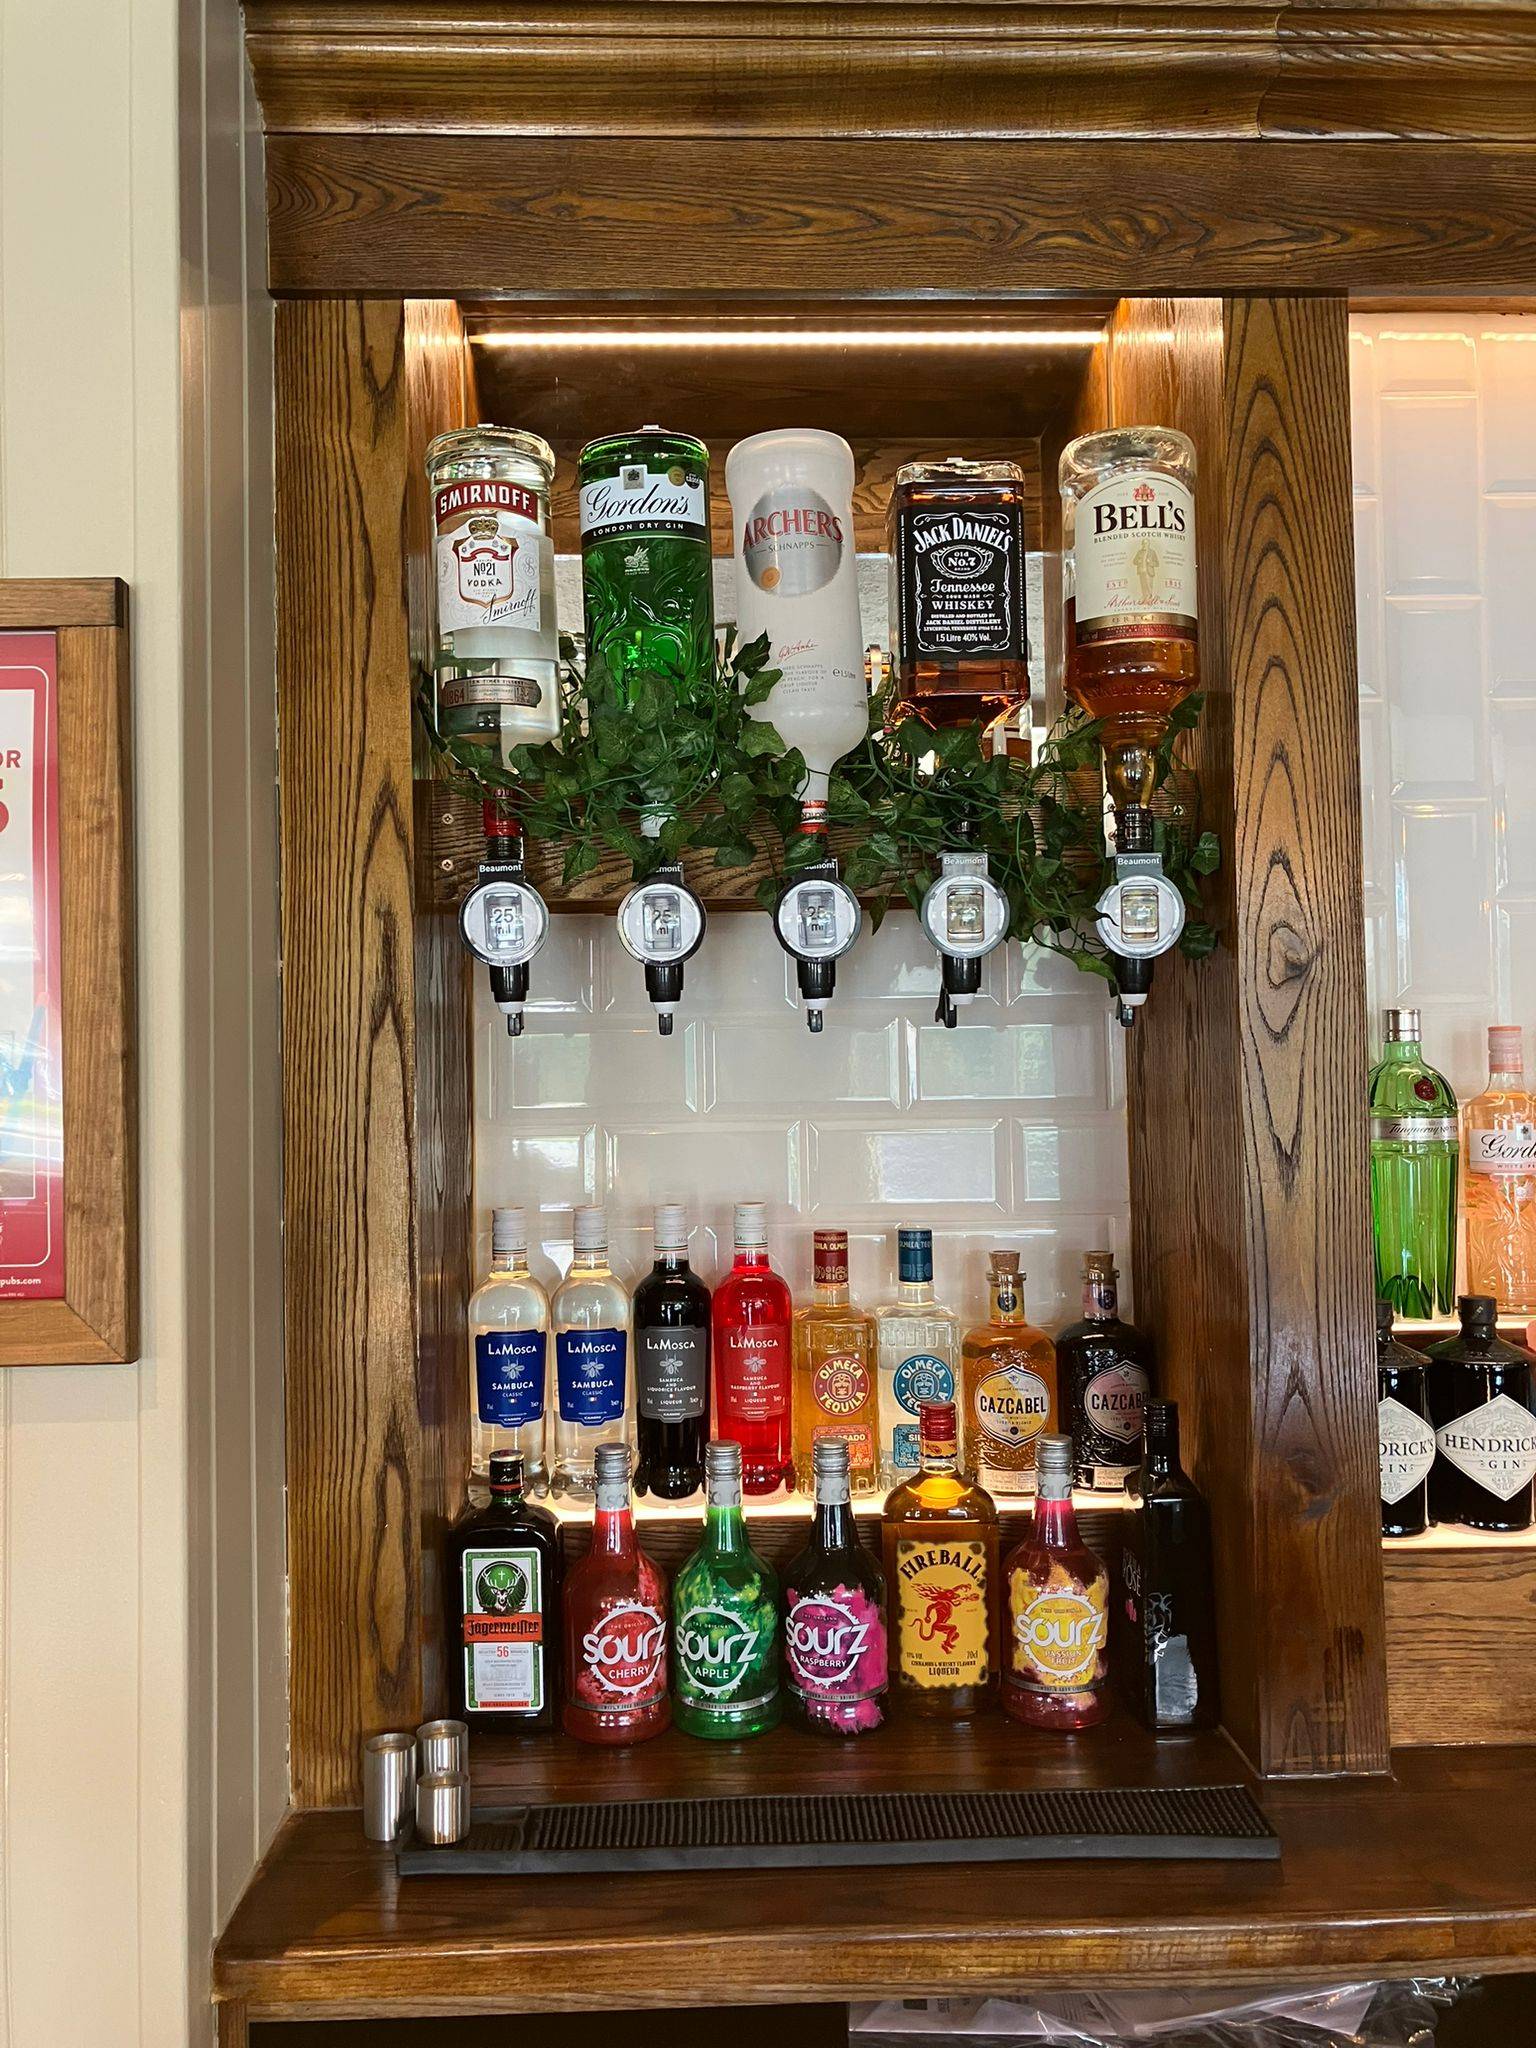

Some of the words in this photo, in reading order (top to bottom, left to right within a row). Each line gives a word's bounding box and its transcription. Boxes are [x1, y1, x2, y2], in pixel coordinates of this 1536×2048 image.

[586, 484, 690, 523] Gordon's
[1093, 501, 1185, 536] BELL'S
[593, 523, 633, 537] LONDON
[639, 522, 660, 530] DRY
[665, 522, 685, 530] GIN
[743, 508, 844, 551] ARCHERS
[913, 523, 952, 553] JACK
[952, 517, 1013, 554] DANIEL'S
[1094, 532, 1129, 544] BLENDED
[1131, 531, 1161, 539] SCOTCH
[1163, 532, 1186, 541] WHISKY
[768, 541, 815, 552] SCHNAPPS
[467, 578, 502, 587] VODKA
[930, 578, 995, 593] Tennessee
[931, 600, 994, 610] WHISKEY
[944, 857, 987, 865] Beaumont
[1117, 857, 1160, 866] Beaumont
[479, 863, 522, 873] Beaumont
[492, 908, 514, 924] 25
[1389, 1123, 1440, 1136] Tanqueray
[819, 1359, 864, 1380] OLMECA
[901, 1359, 944, 1380] OLMECA
[492, 1381, 534, 1391] SAMBUCA
[572, 1379, 614, 1389] SAMBUCA
[819, 1391, 866, 1413] TEQUILA
[980, 1395, 1047, 1414] CAZCABEL
[1488, 1460, 1520, 1469] GIN
[899, 1549, 983, 1581] FIREBALL
[497, 1646, 510, 1658] 56
[800, 1655, 846, 1667] RASPBERRY
[608, 1665, 650, 1680] CHERRY
[694, 1666, 729, 1679] APPLE
[929, 1667, 960, 1676] LIQUEUR
